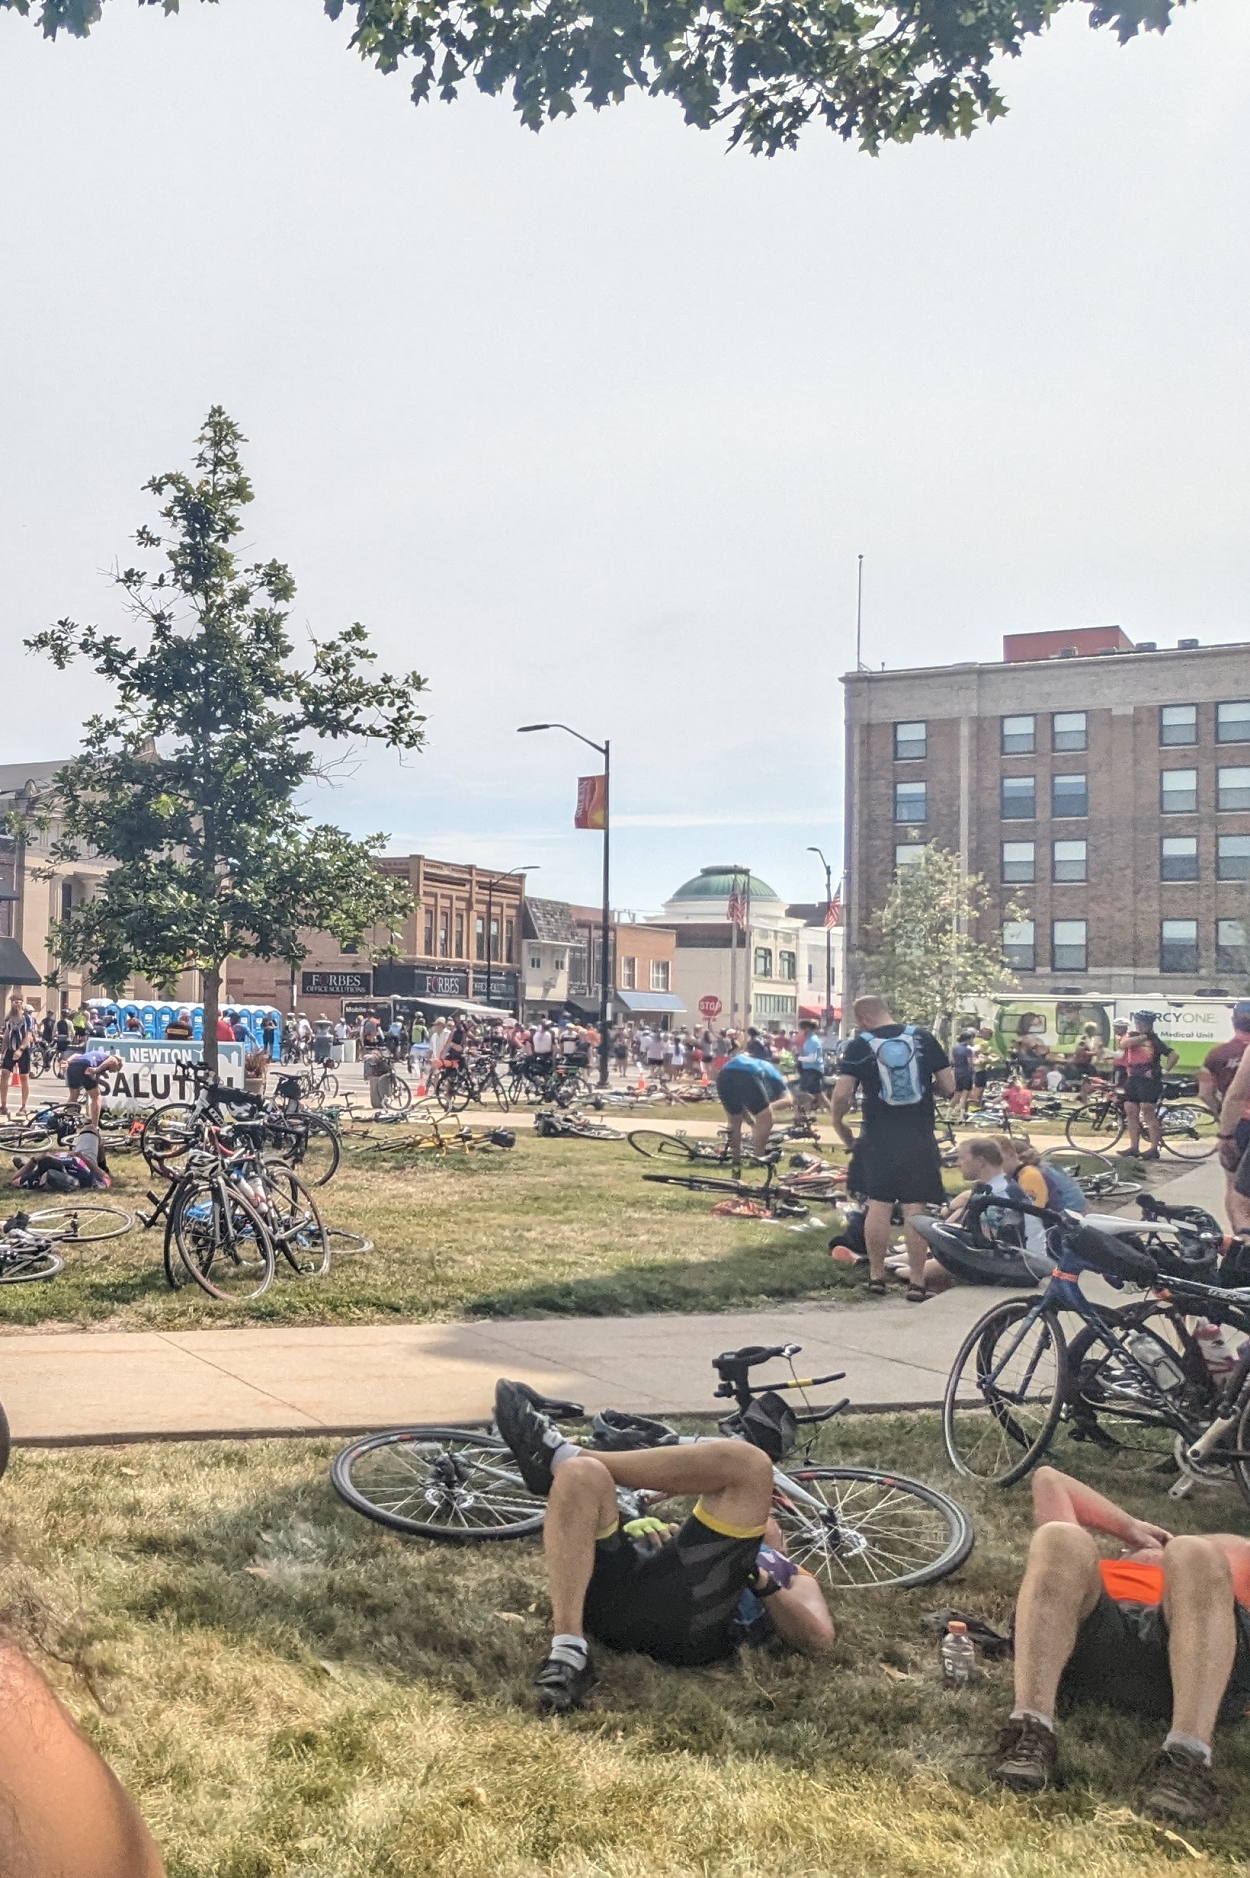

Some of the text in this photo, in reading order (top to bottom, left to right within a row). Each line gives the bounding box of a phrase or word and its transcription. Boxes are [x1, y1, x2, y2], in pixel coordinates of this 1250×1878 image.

[312, 974, 361, 987] FORBES
[426, 975, 460, 994] FORBES
[700, 1001, 721, 1010] STOP
[1160, 1031, 1194, 1039] Medical
[129, 1047, 192, 1064] NEWTON
